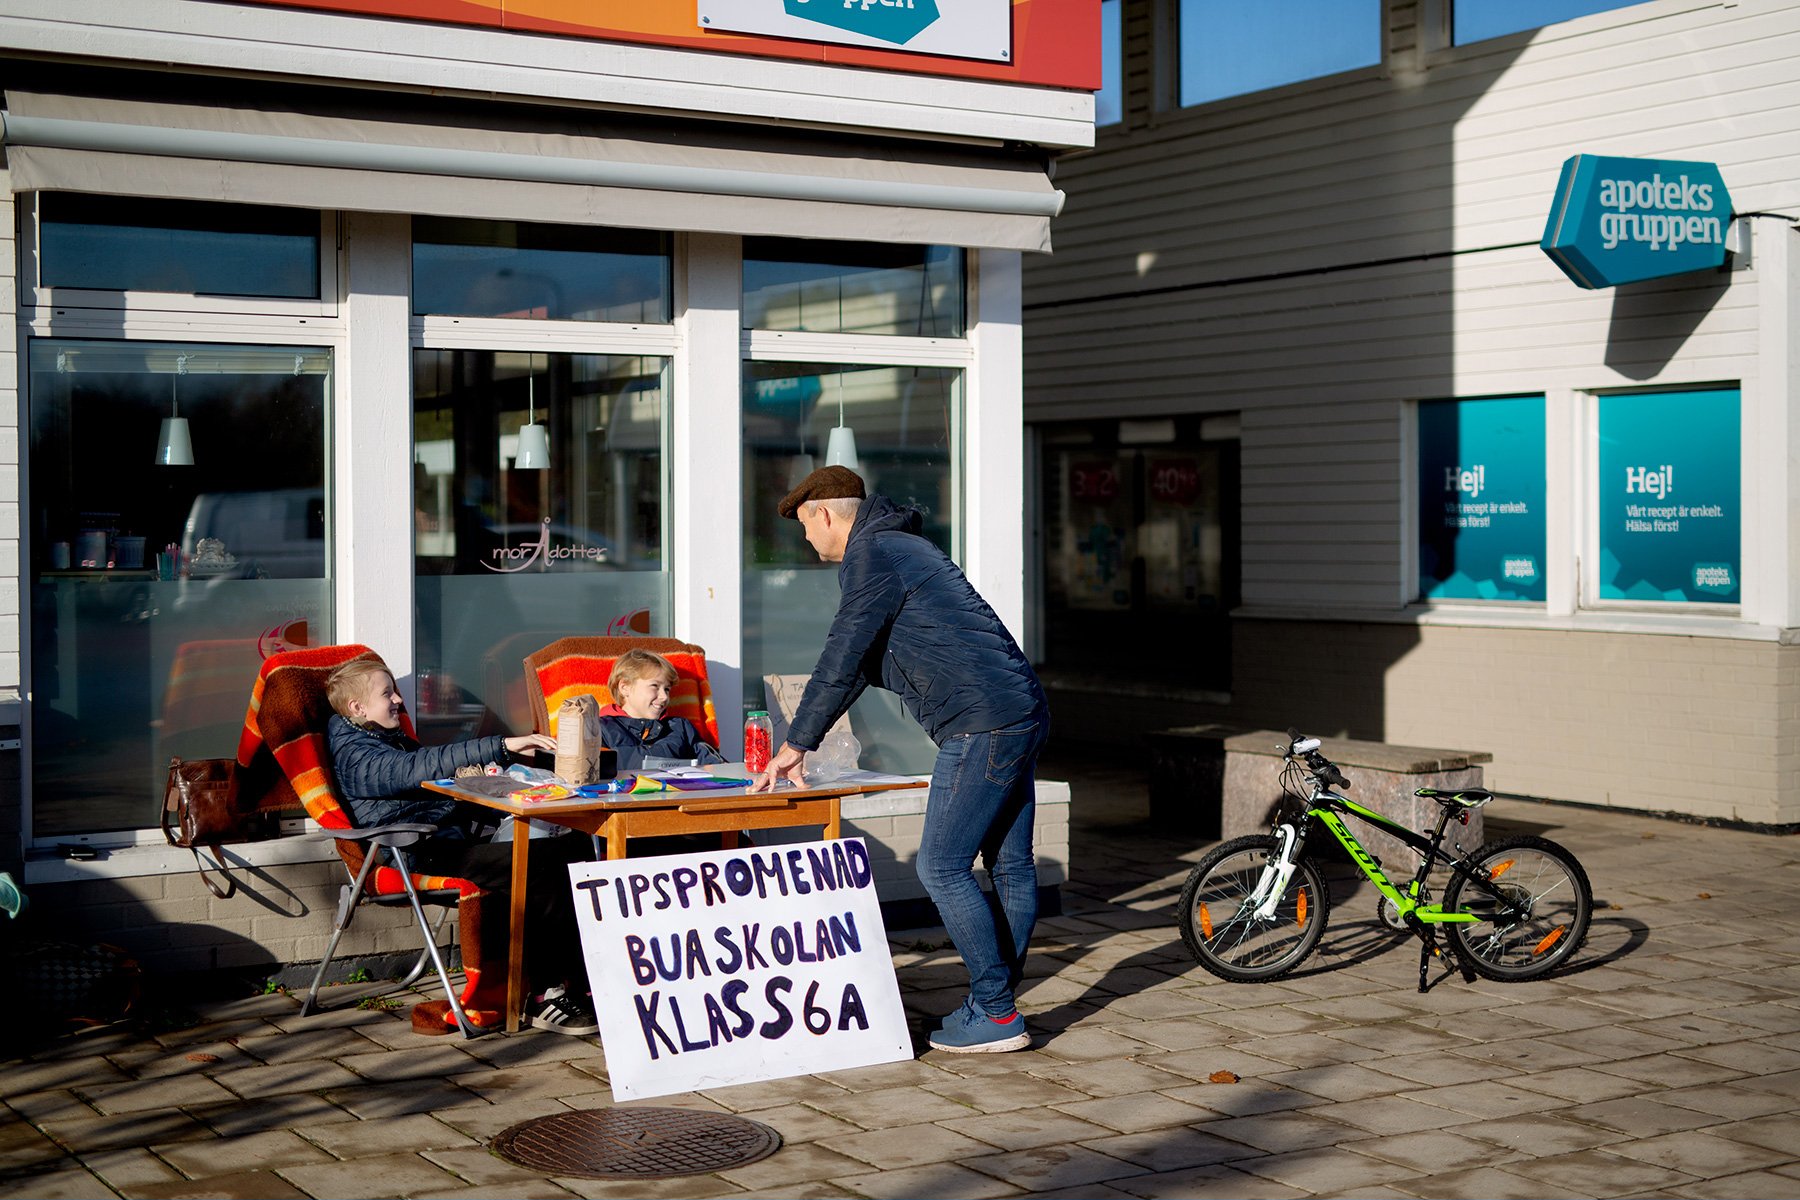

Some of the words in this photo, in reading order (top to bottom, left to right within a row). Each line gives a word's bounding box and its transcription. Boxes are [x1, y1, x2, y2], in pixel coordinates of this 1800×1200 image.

[1600, 173, 1713, 213] apoteks
[1600, 212, 1722, 251] gruppen
[1445, 464, 1484, 498] Hej!
[1625, 465, 1673, 500] Hej!
[1463, 502, 1488, 516] recept
[1489, 501, 1499, 514] är
[1499, 501, 1528, 514] enkelt.
[1625, 504, 1646, 517] Vårt
[1647, 505, 1677, 519] recept
[1678, 504, 1689, 517] är
[1690, 504, 1724, 517] enkelt.
[1625, 519, 1653, 532] Hälsa
[1653, 519, 1679, 532] först!
[548, 544, 608, 559] dotter
[1696, 567, 1729, 577] apoteks
[1696, 575, 1731, 587] gruppen
[1330, 821, 1391, 887] SCOTT
[576, 840, 872, 921] TIPSPROMENAD
